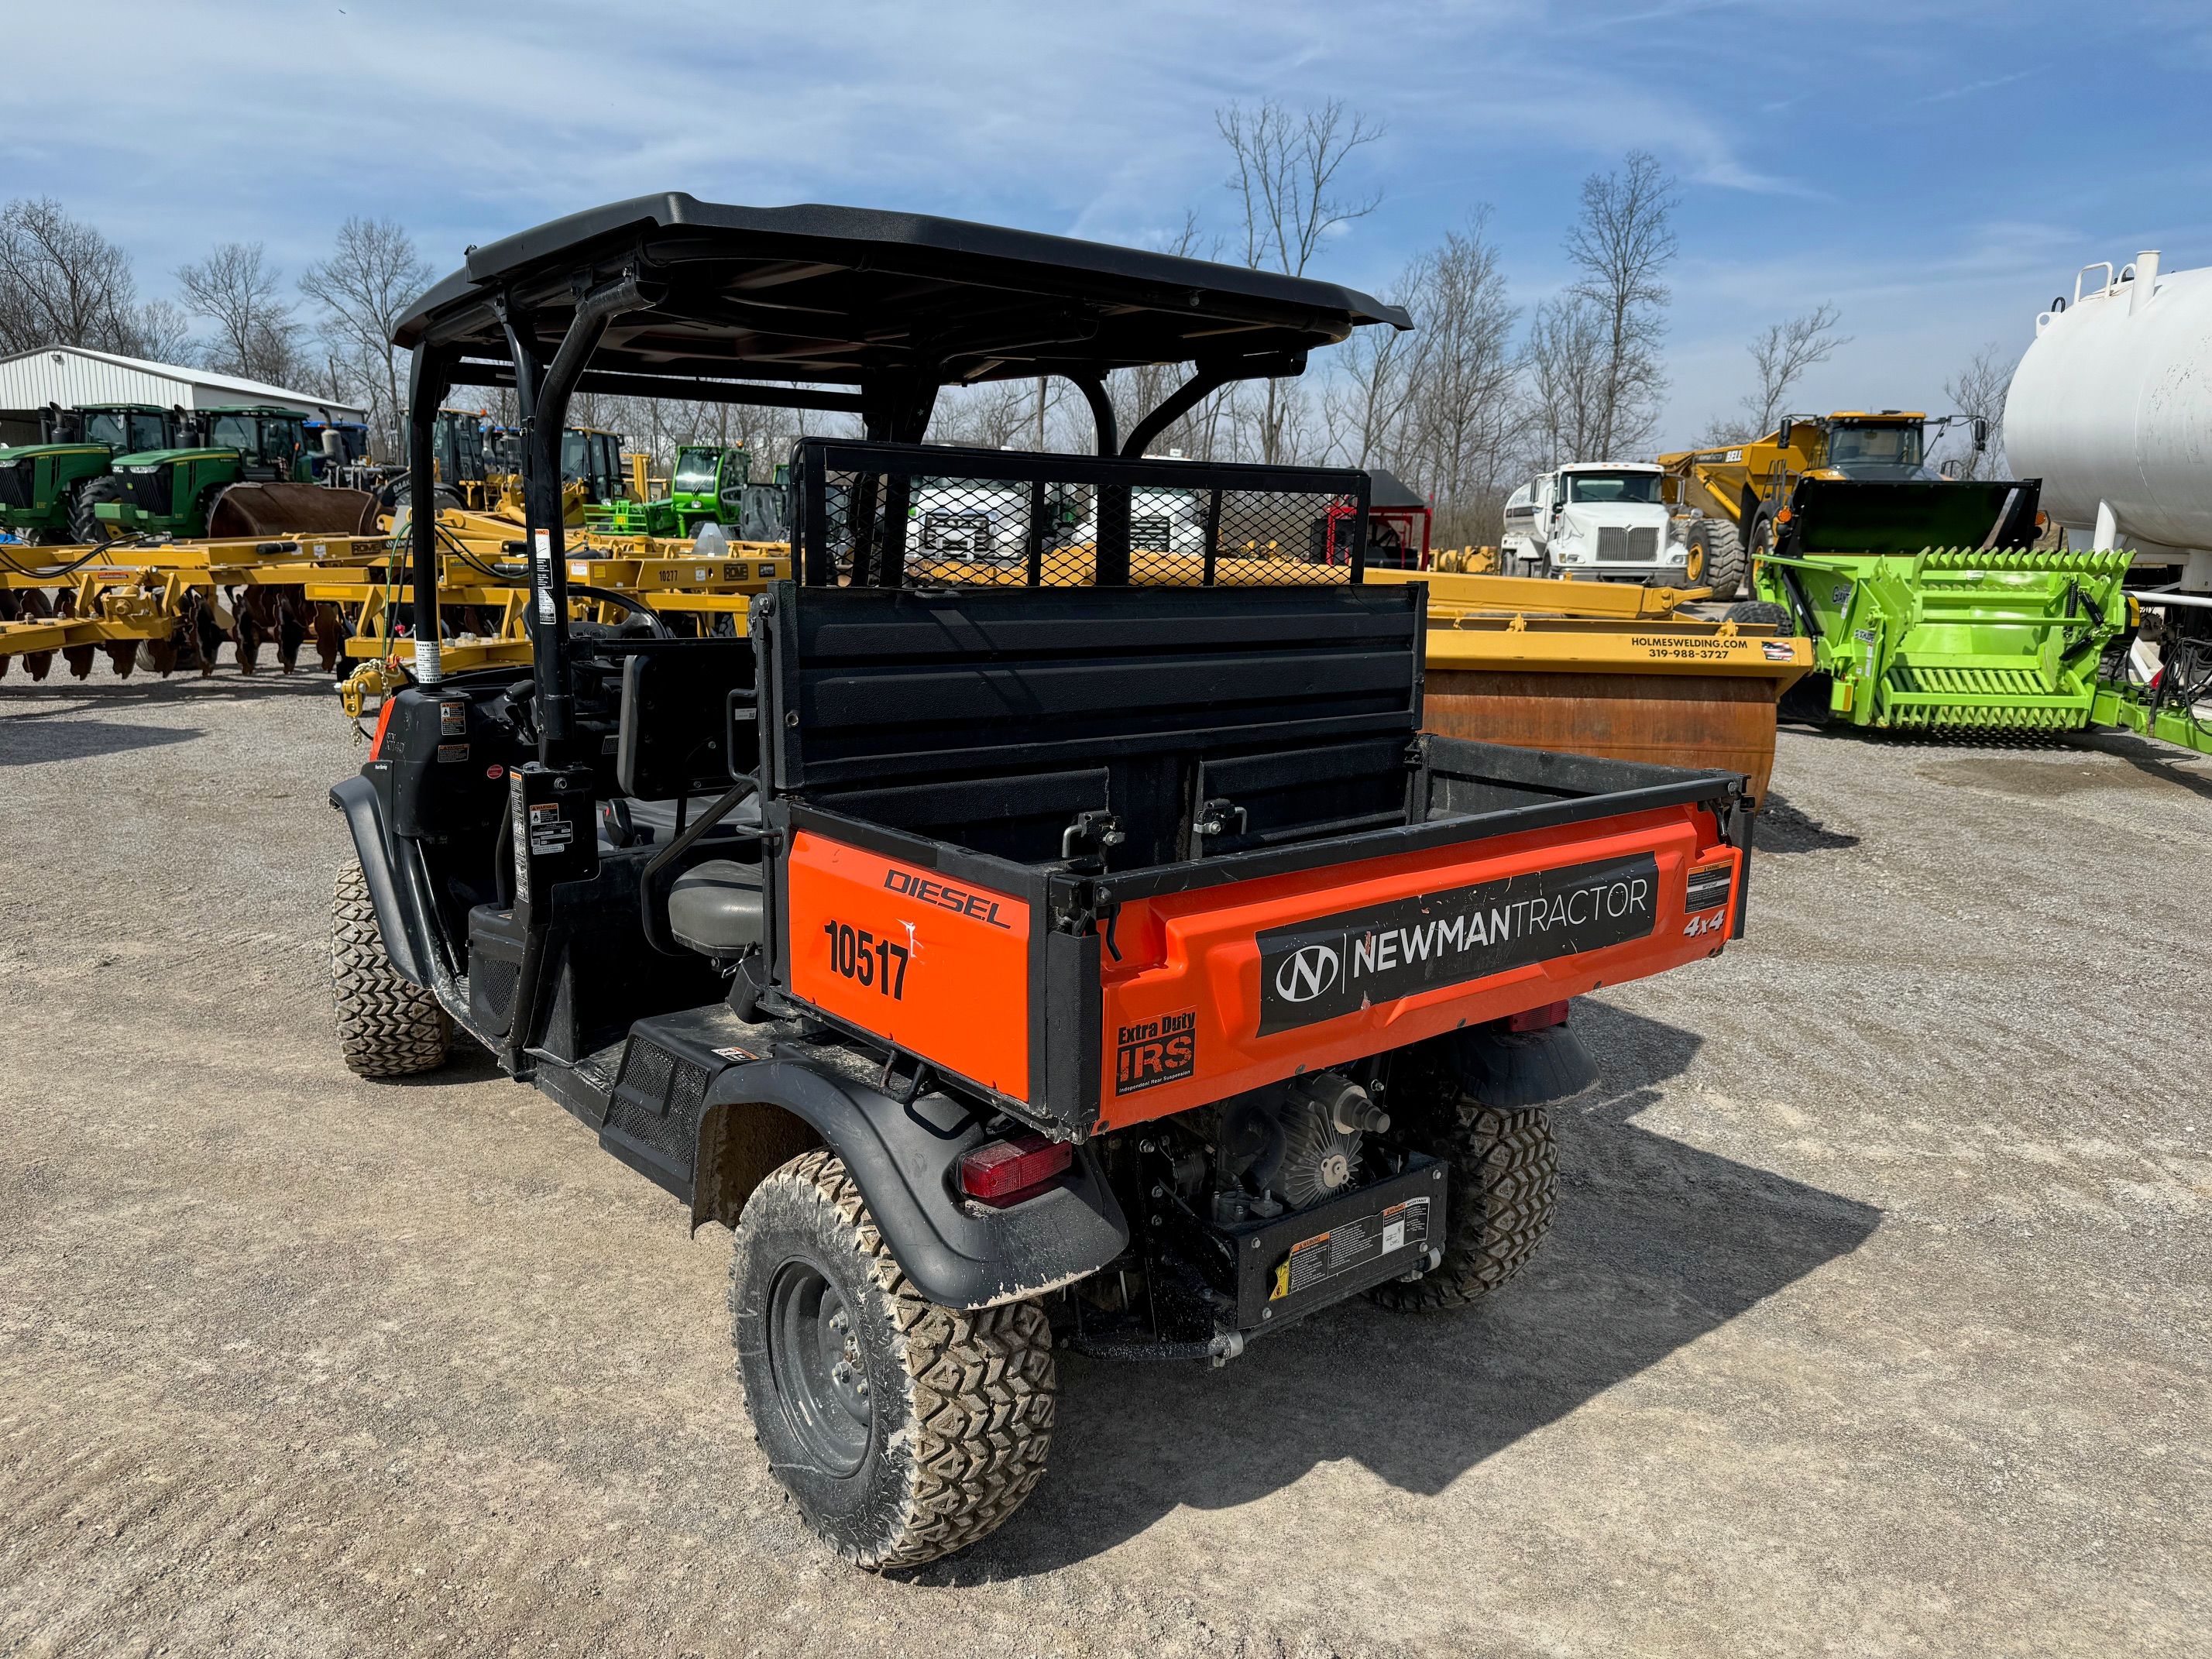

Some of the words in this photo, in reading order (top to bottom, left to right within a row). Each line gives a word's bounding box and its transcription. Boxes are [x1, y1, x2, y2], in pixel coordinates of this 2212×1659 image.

[1725, 450, 1742, 462] BELL
[659, 570, 678, 581] 10277
[1632, 637, 1747, 648] HOLMESWELDING.COM
[1649, 649, 1729, 658] 319-988-3727
[884, 869, 1011, 929] DIESEL
[1683, 909, 1726, 938] 4x4
[824, 919, 908, 1001] 10517
[1118, 1022, 1158, 1045] Extra
[1162, 1012, 1195, 1035] Duty
[1120, 1036, 1192, 1082] IRS
[1118, 1081, 1150, 1093] Independent
[1163, 1070, 1190, 1081] Suspension
